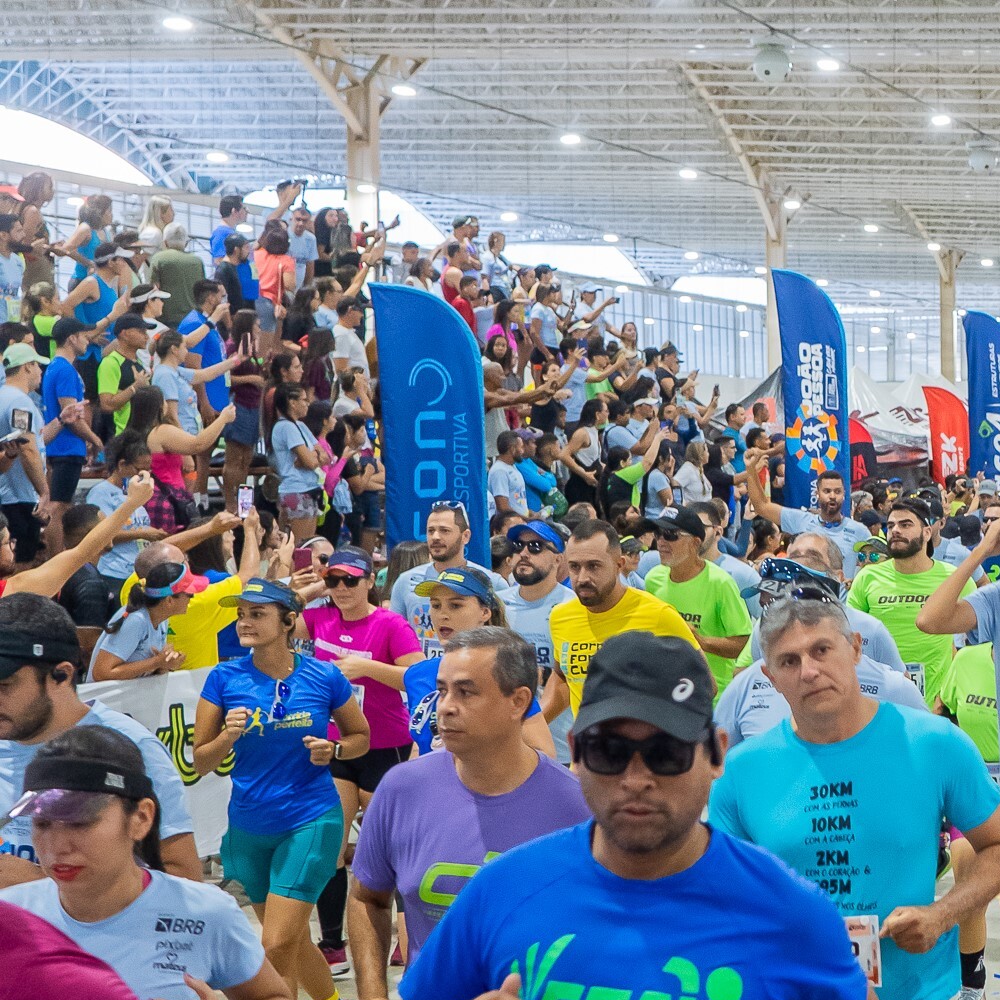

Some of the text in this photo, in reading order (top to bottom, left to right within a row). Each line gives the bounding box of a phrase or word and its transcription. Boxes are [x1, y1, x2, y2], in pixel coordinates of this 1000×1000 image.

[797, 342, 812, 416] JOÃO
[812, 343, 823, 416] PESSOA
[453, 412, 470, 511] SPORTIVA
[809, 781, 853, 801] 30KM
[811, 815, 851, 833] 10KM
[816, 850, 849, 867] 2KM
[817, 879, 851, 895] 95M
[173, 918, 206, 935] BRB
